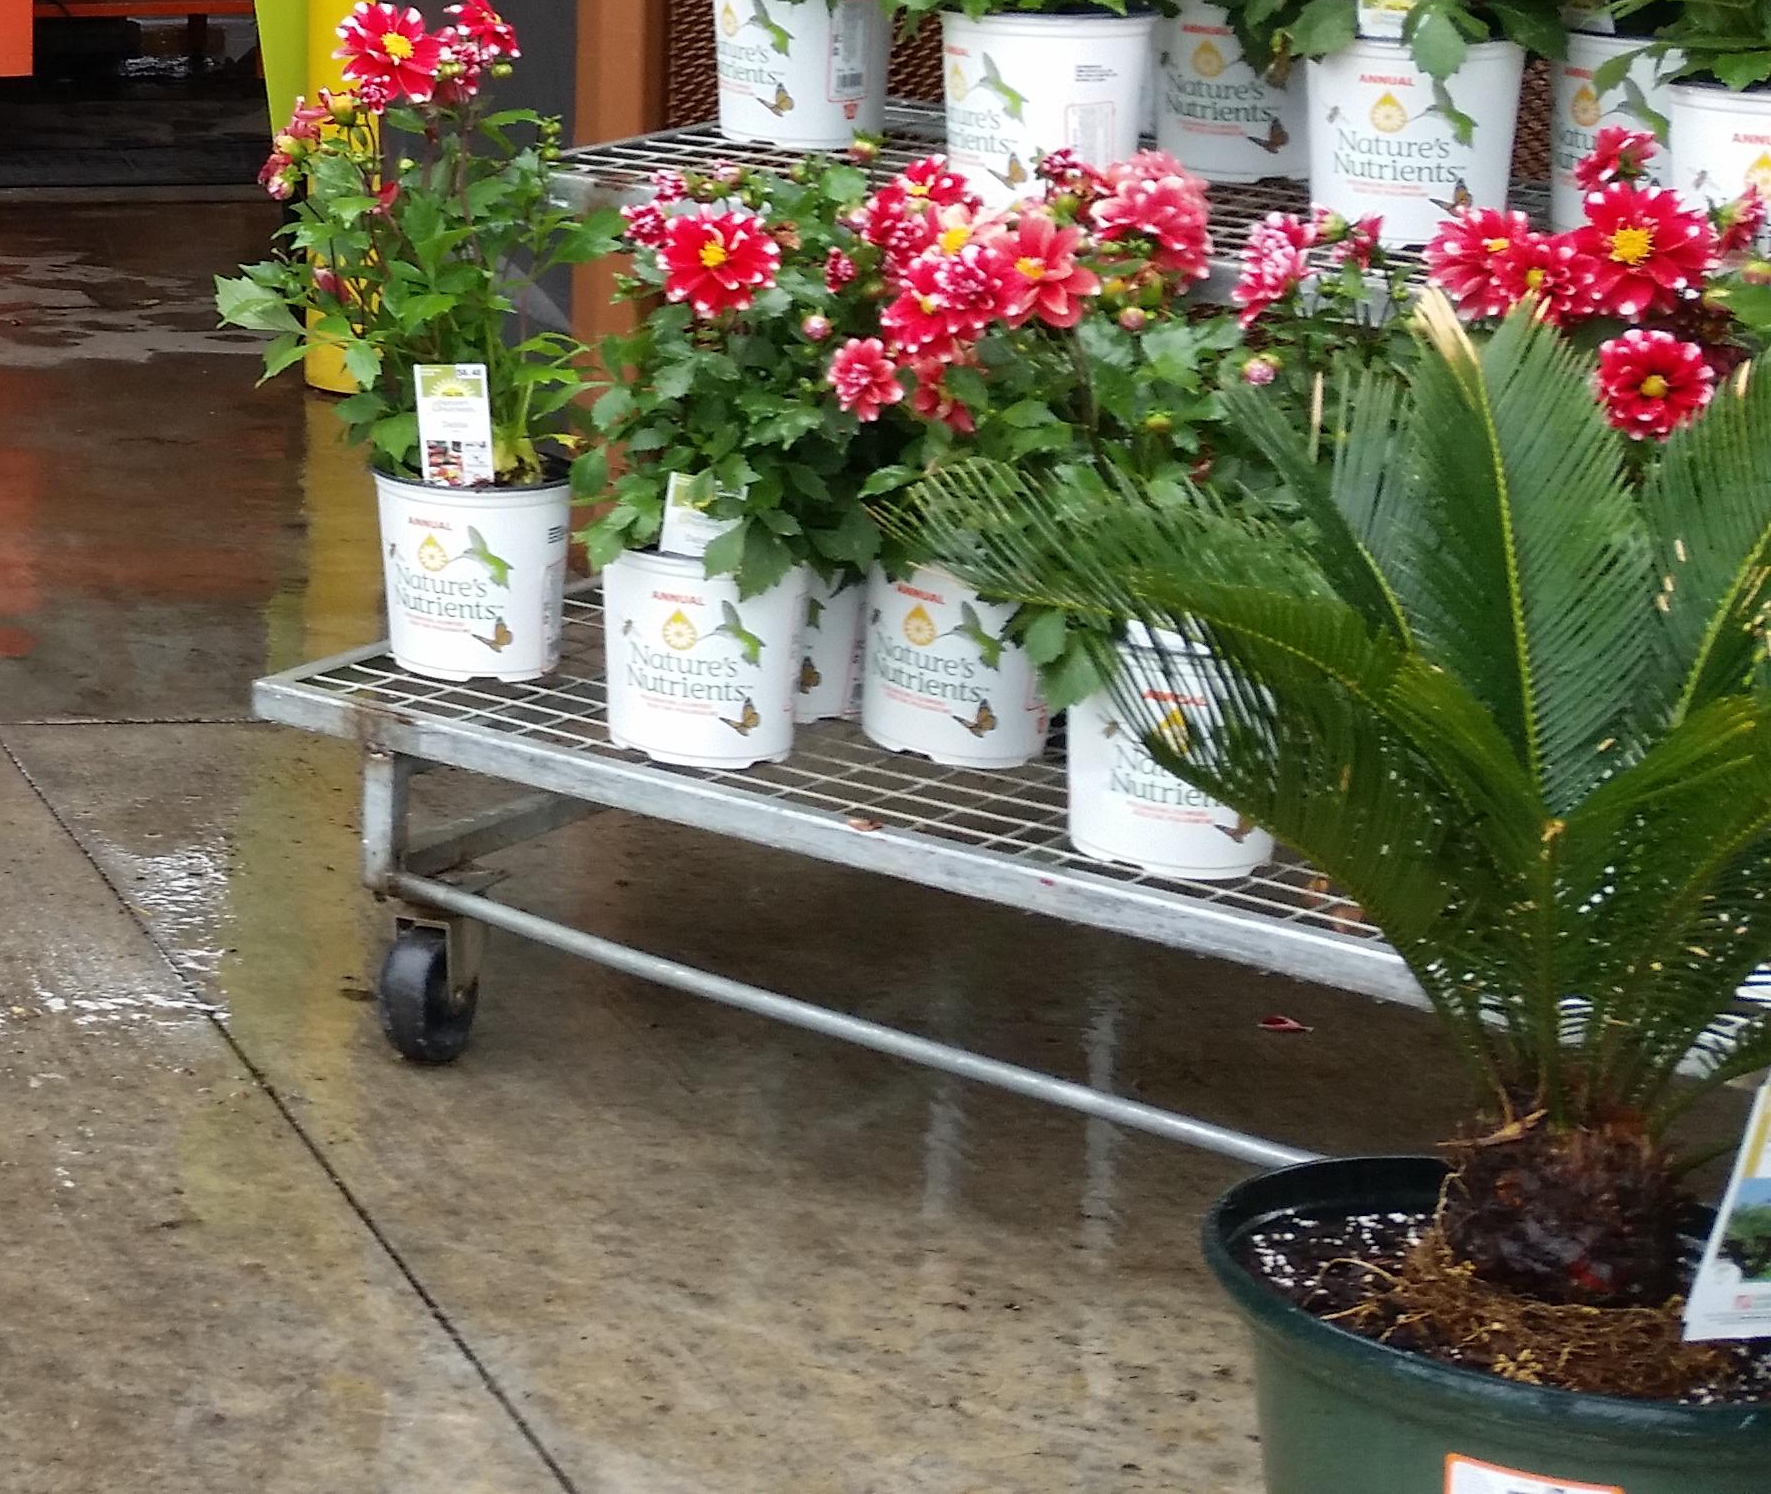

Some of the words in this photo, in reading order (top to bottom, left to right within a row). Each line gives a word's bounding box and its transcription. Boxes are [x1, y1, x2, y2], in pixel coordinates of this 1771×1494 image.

[1359, 73, 1415, 87] ANNUAL
[1337, 127, 1450, 159] Nature's
[1334, 150, 1459, 184] Nutrients
[408, 516, 453, 531] ANNUAL
[396, 562, 488, 599] Nature's
[394, 582, 497, 621] Nutrients
[652, 590, 705, 606] ANNUAL
[629, 641, 738, 679] Nature's
[627, 664, 746, 703] Nutrients
